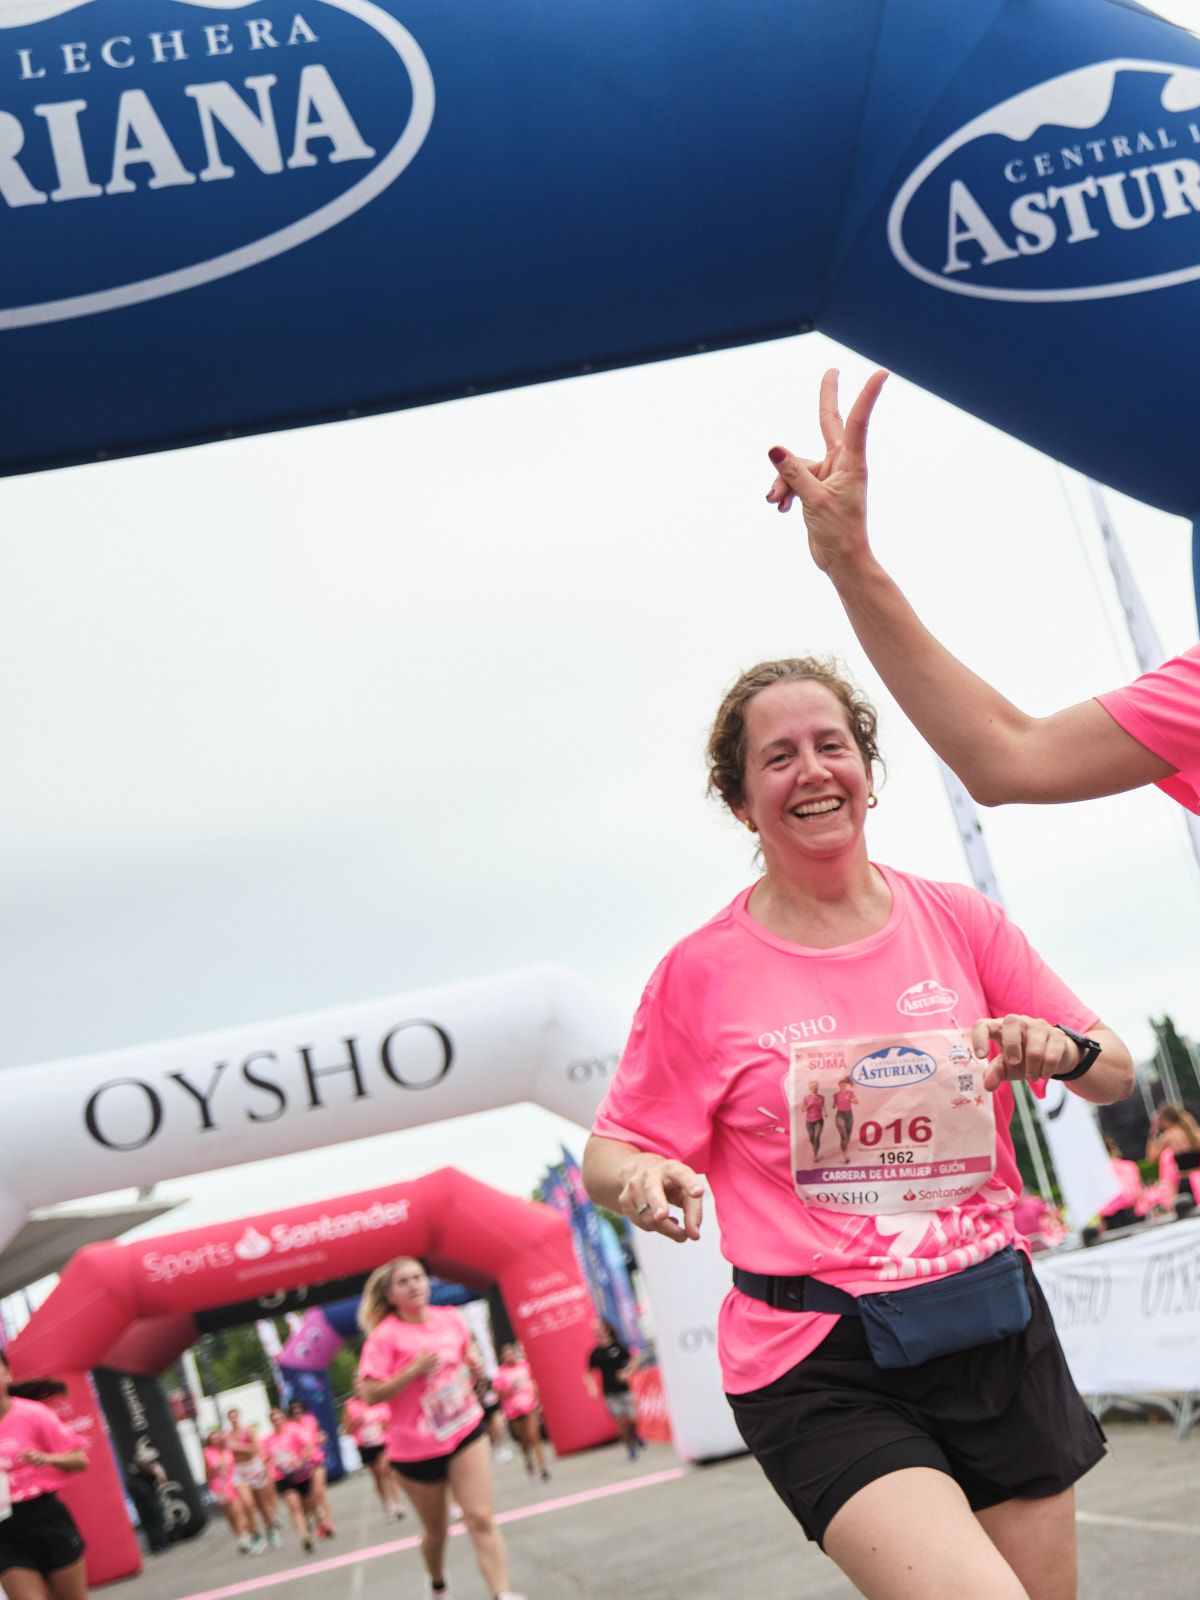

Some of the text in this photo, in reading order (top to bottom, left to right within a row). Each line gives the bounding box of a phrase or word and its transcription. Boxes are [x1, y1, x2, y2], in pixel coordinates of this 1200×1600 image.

[17, 14, 319, 80] LECHERA
[1004, 126, 1177, 184] CENTRAL
[757, 1014, 837, 1050] OYSHO
[809, 1058, 848, 1071] SUMA
[858, 1063, 931, 1081] ASTURIANA
[84, 1018, 456, 1152] OYSHO
[858, 1115, 933, 1147] 016
[879, 1150, 914, 1165] 1962
[822, 1169, 867, 1182] CARRERA
[869, 1169, 882, 1180] DE
[884, 1168, 897, 1179] LA
[899, 1166, 932, 1178] MUJER
[816, 1184, 974, 1205] OYSHO Santander
[142, 1242, 236, 1284] Sports
[270, 1198, 411, 1253] Santander
